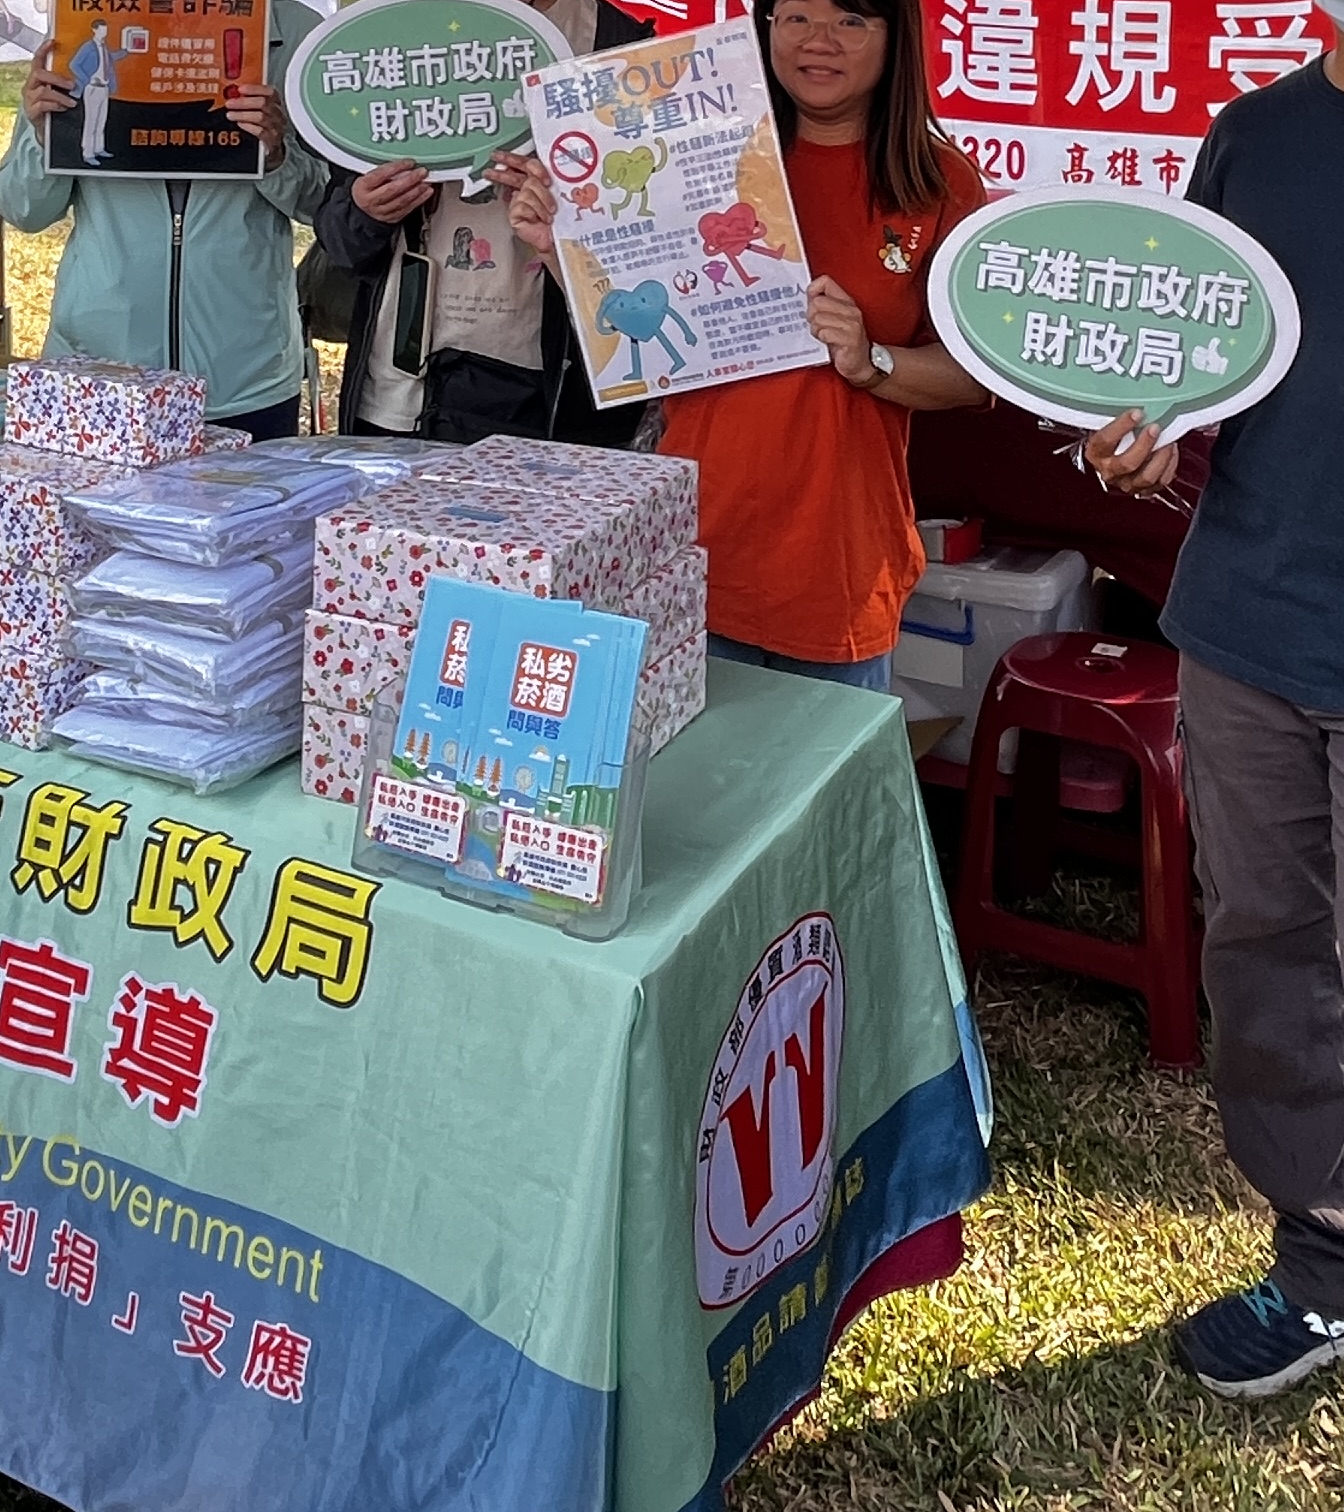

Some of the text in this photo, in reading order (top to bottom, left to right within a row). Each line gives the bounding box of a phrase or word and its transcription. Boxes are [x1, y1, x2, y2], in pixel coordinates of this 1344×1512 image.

[318, 36, 538, 94] 高雄市政府
[543, 47, 718, 119] 騷擾OUT!
[369, 94, 501, 143] 財政局
[613, 83, 738, 139] 尊重IN!
[951, 135, 1025, 180] 320
[976, 240, 1250, 328] 高雄市政府
[1021, 312, 1184, 384] 財政局
[520, 645, 573, 681] 私劣
[436, 687, 464, 709] 問與
[515, 676, 568, 714] 菸酒
[506, 710, 560, 741] 問與答
[42, 1134, 325, 1302] Government
